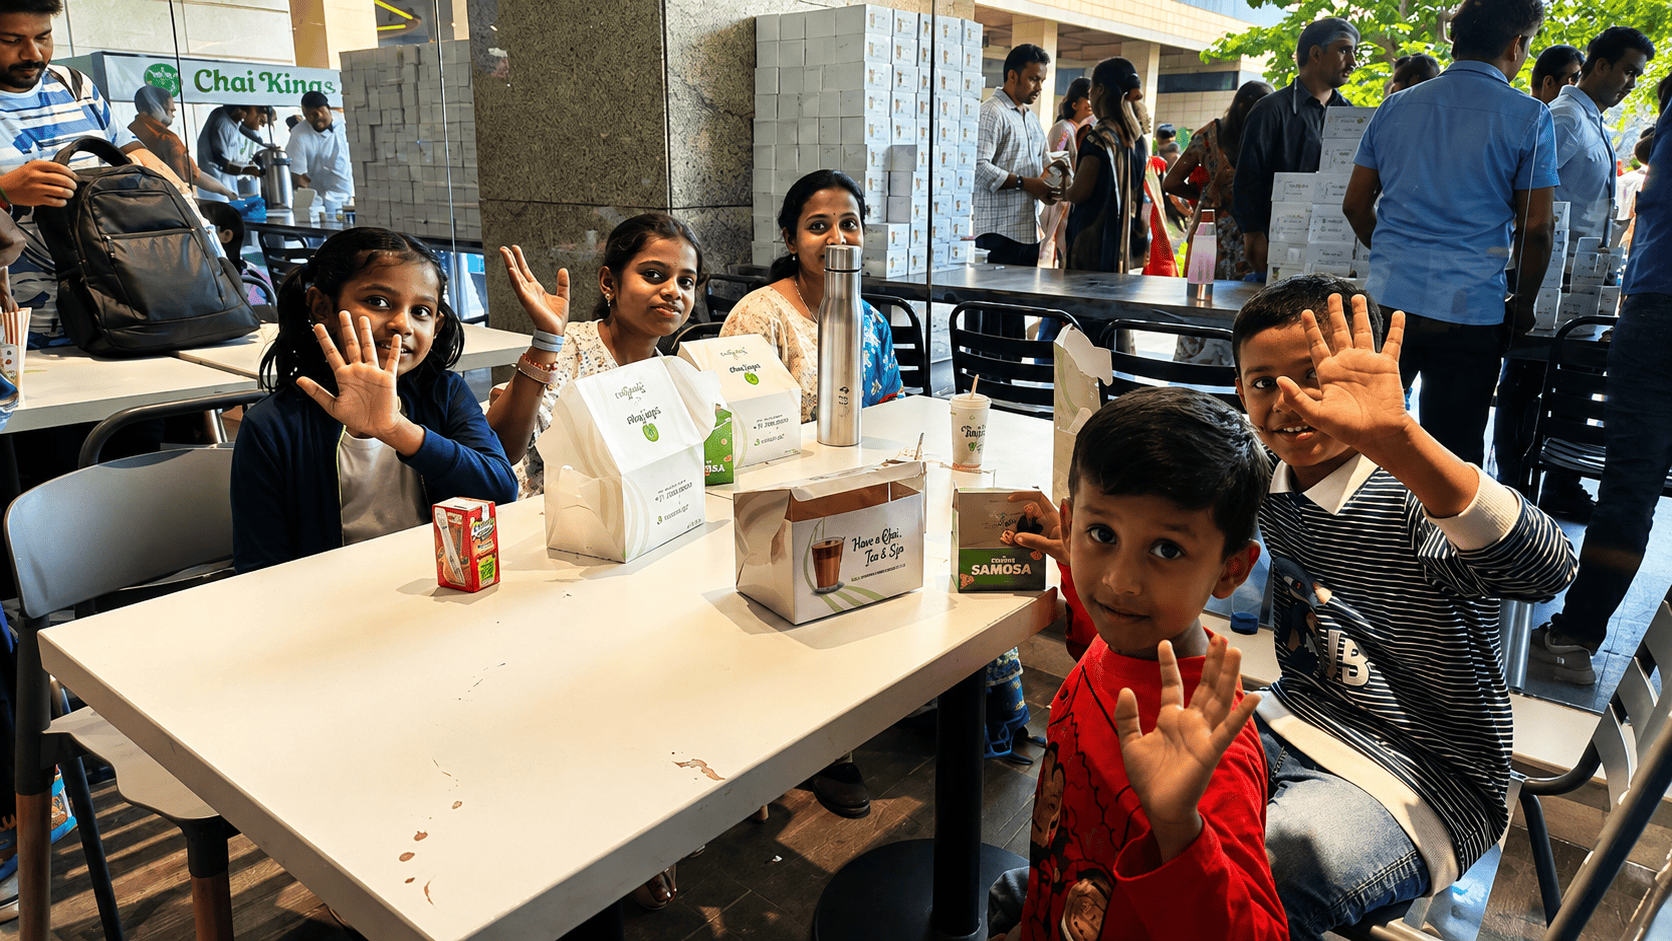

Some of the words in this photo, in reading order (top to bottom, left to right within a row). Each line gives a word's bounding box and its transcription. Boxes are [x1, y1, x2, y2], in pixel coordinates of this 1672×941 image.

[194, 69, 256, 93] Chai
[259, 71, 336, 95] Kings
[851, 535, 874, 552] Have
[875, 536, 881, 544] a
[880, 547, 887, 560] &
[888, 543, 904, 560] Sip
[971, 563, 1032, 575] SAMOSA
